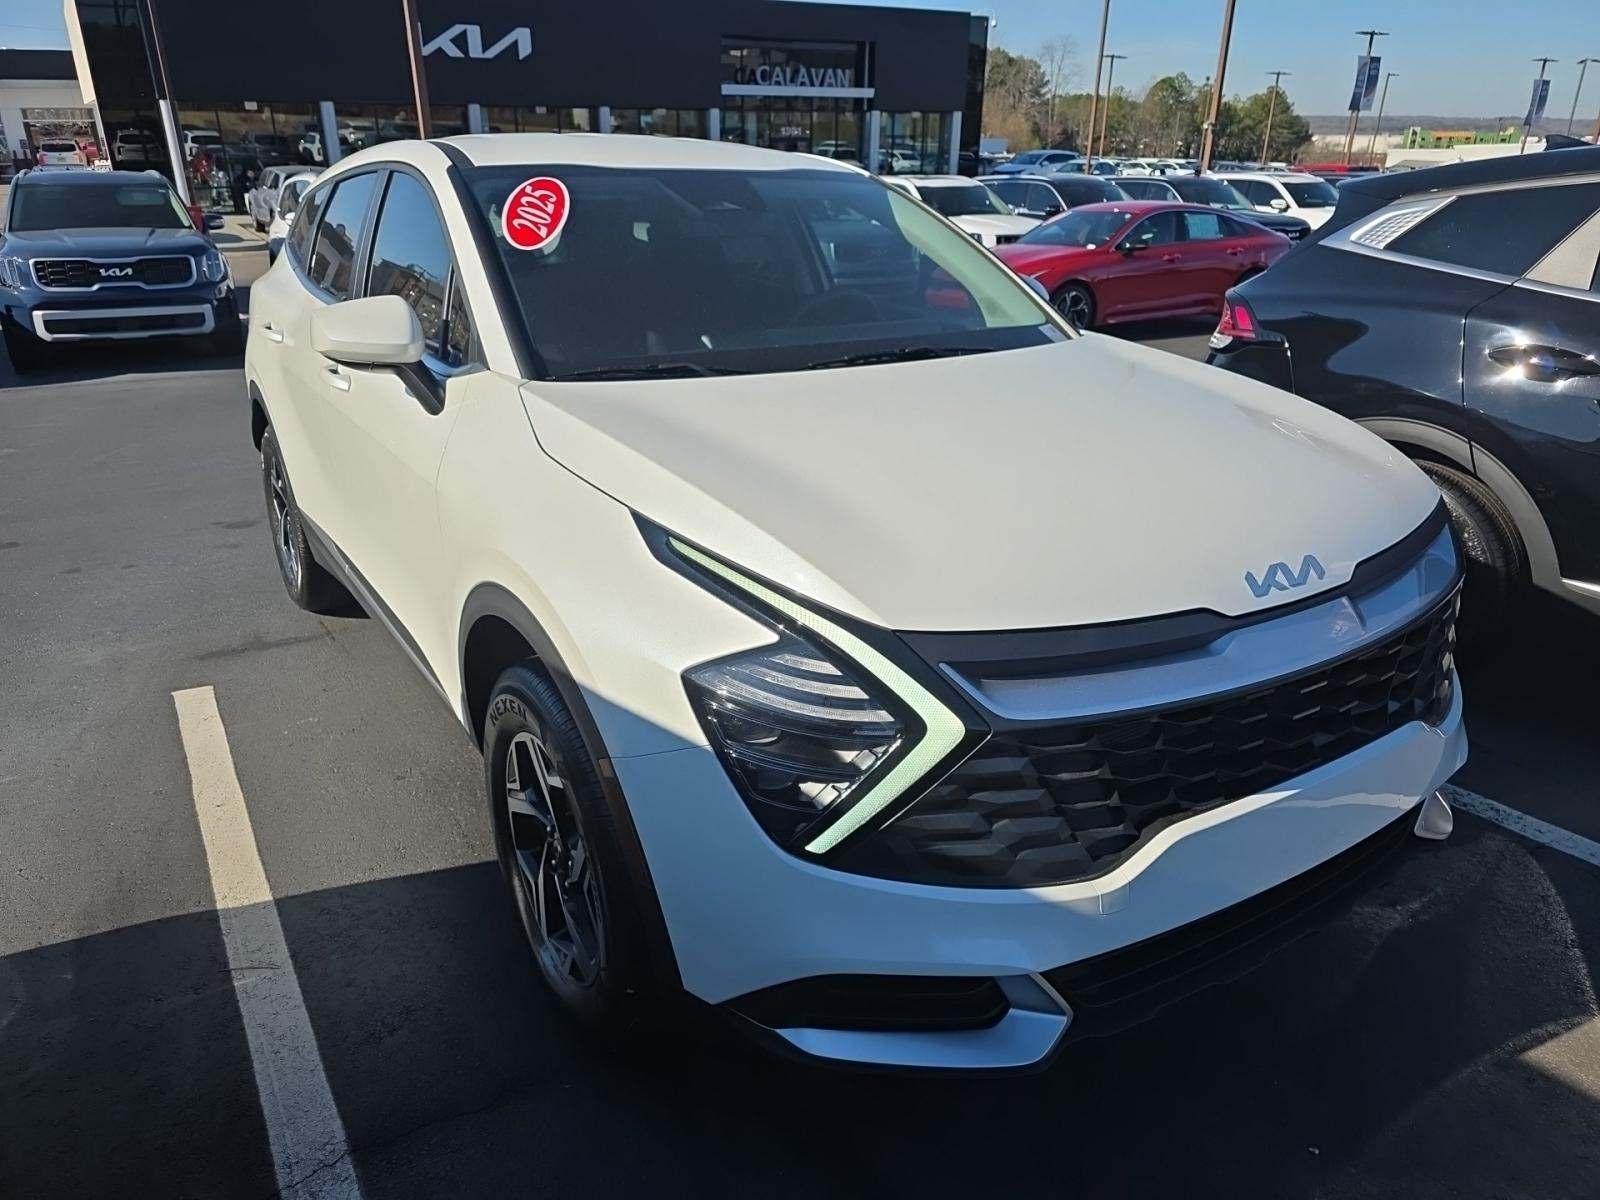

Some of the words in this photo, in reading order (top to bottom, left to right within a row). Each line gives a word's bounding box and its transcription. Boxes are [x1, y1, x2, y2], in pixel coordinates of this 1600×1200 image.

[755, 65, 850, 88] CALAVAN
[512, 185, 557, 239] 2025
[1244, 554, 1326, 598] KIA
[489, 698, 528, 728] NEXEN
